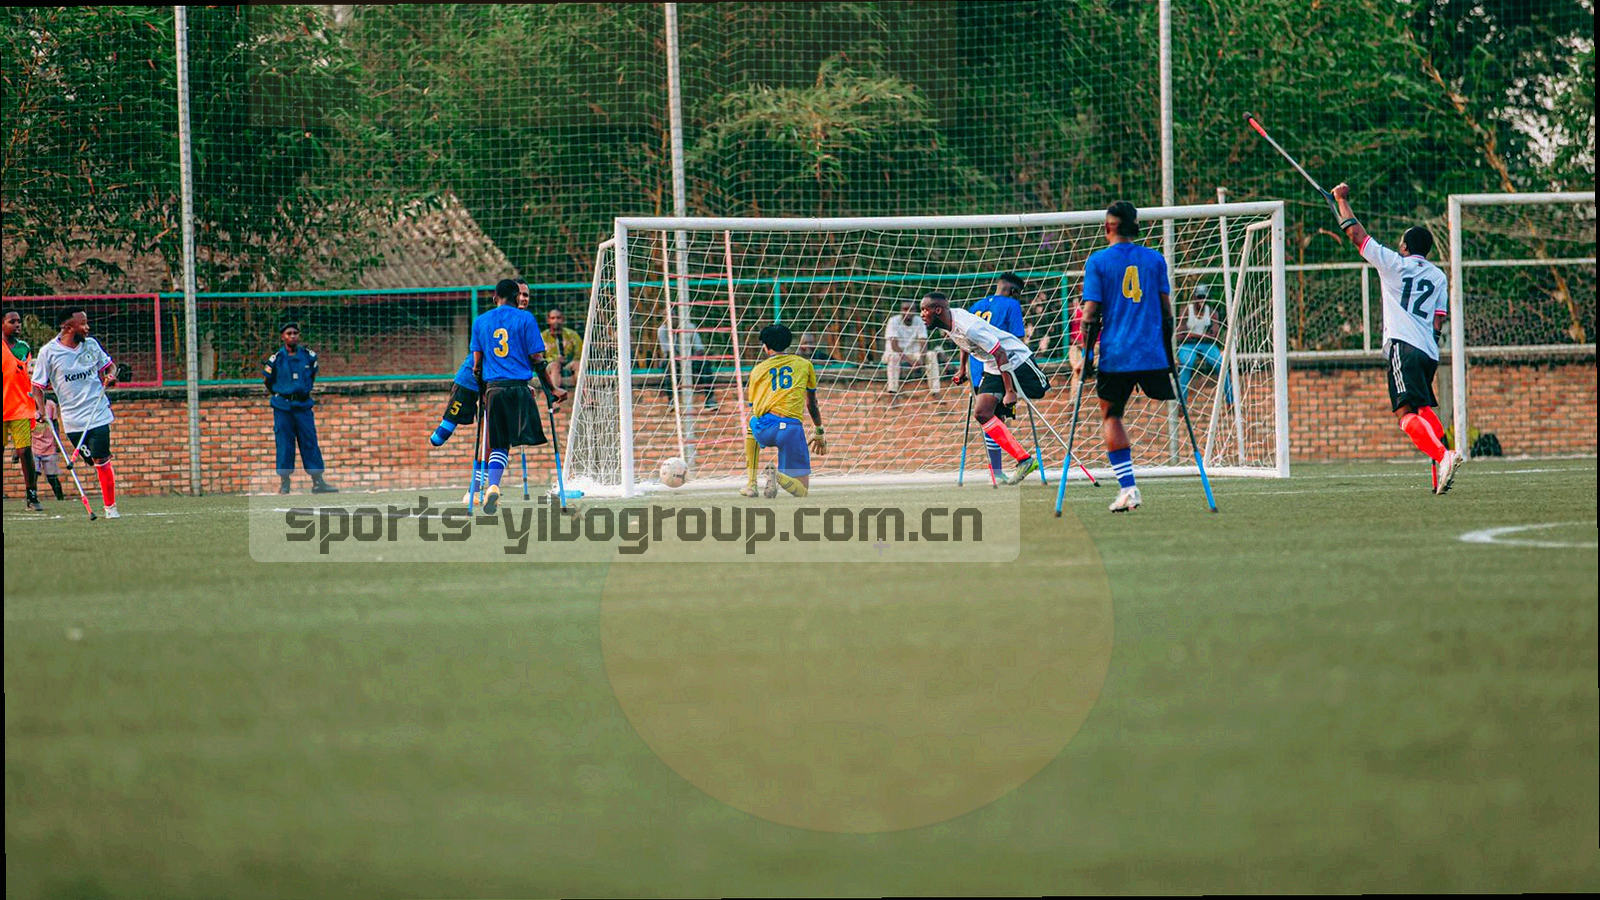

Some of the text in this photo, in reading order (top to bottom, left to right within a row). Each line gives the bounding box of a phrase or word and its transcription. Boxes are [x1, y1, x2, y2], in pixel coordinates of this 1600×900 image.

[1122, 265, 1142, 303] 4
[1400, 277, 1435, 319] 12
[493, 328, 509, 358] 3
[769, 366, 792, 392] 16
[450, 401, 462, 415] 5
[80, 445, 91, 457] 8
